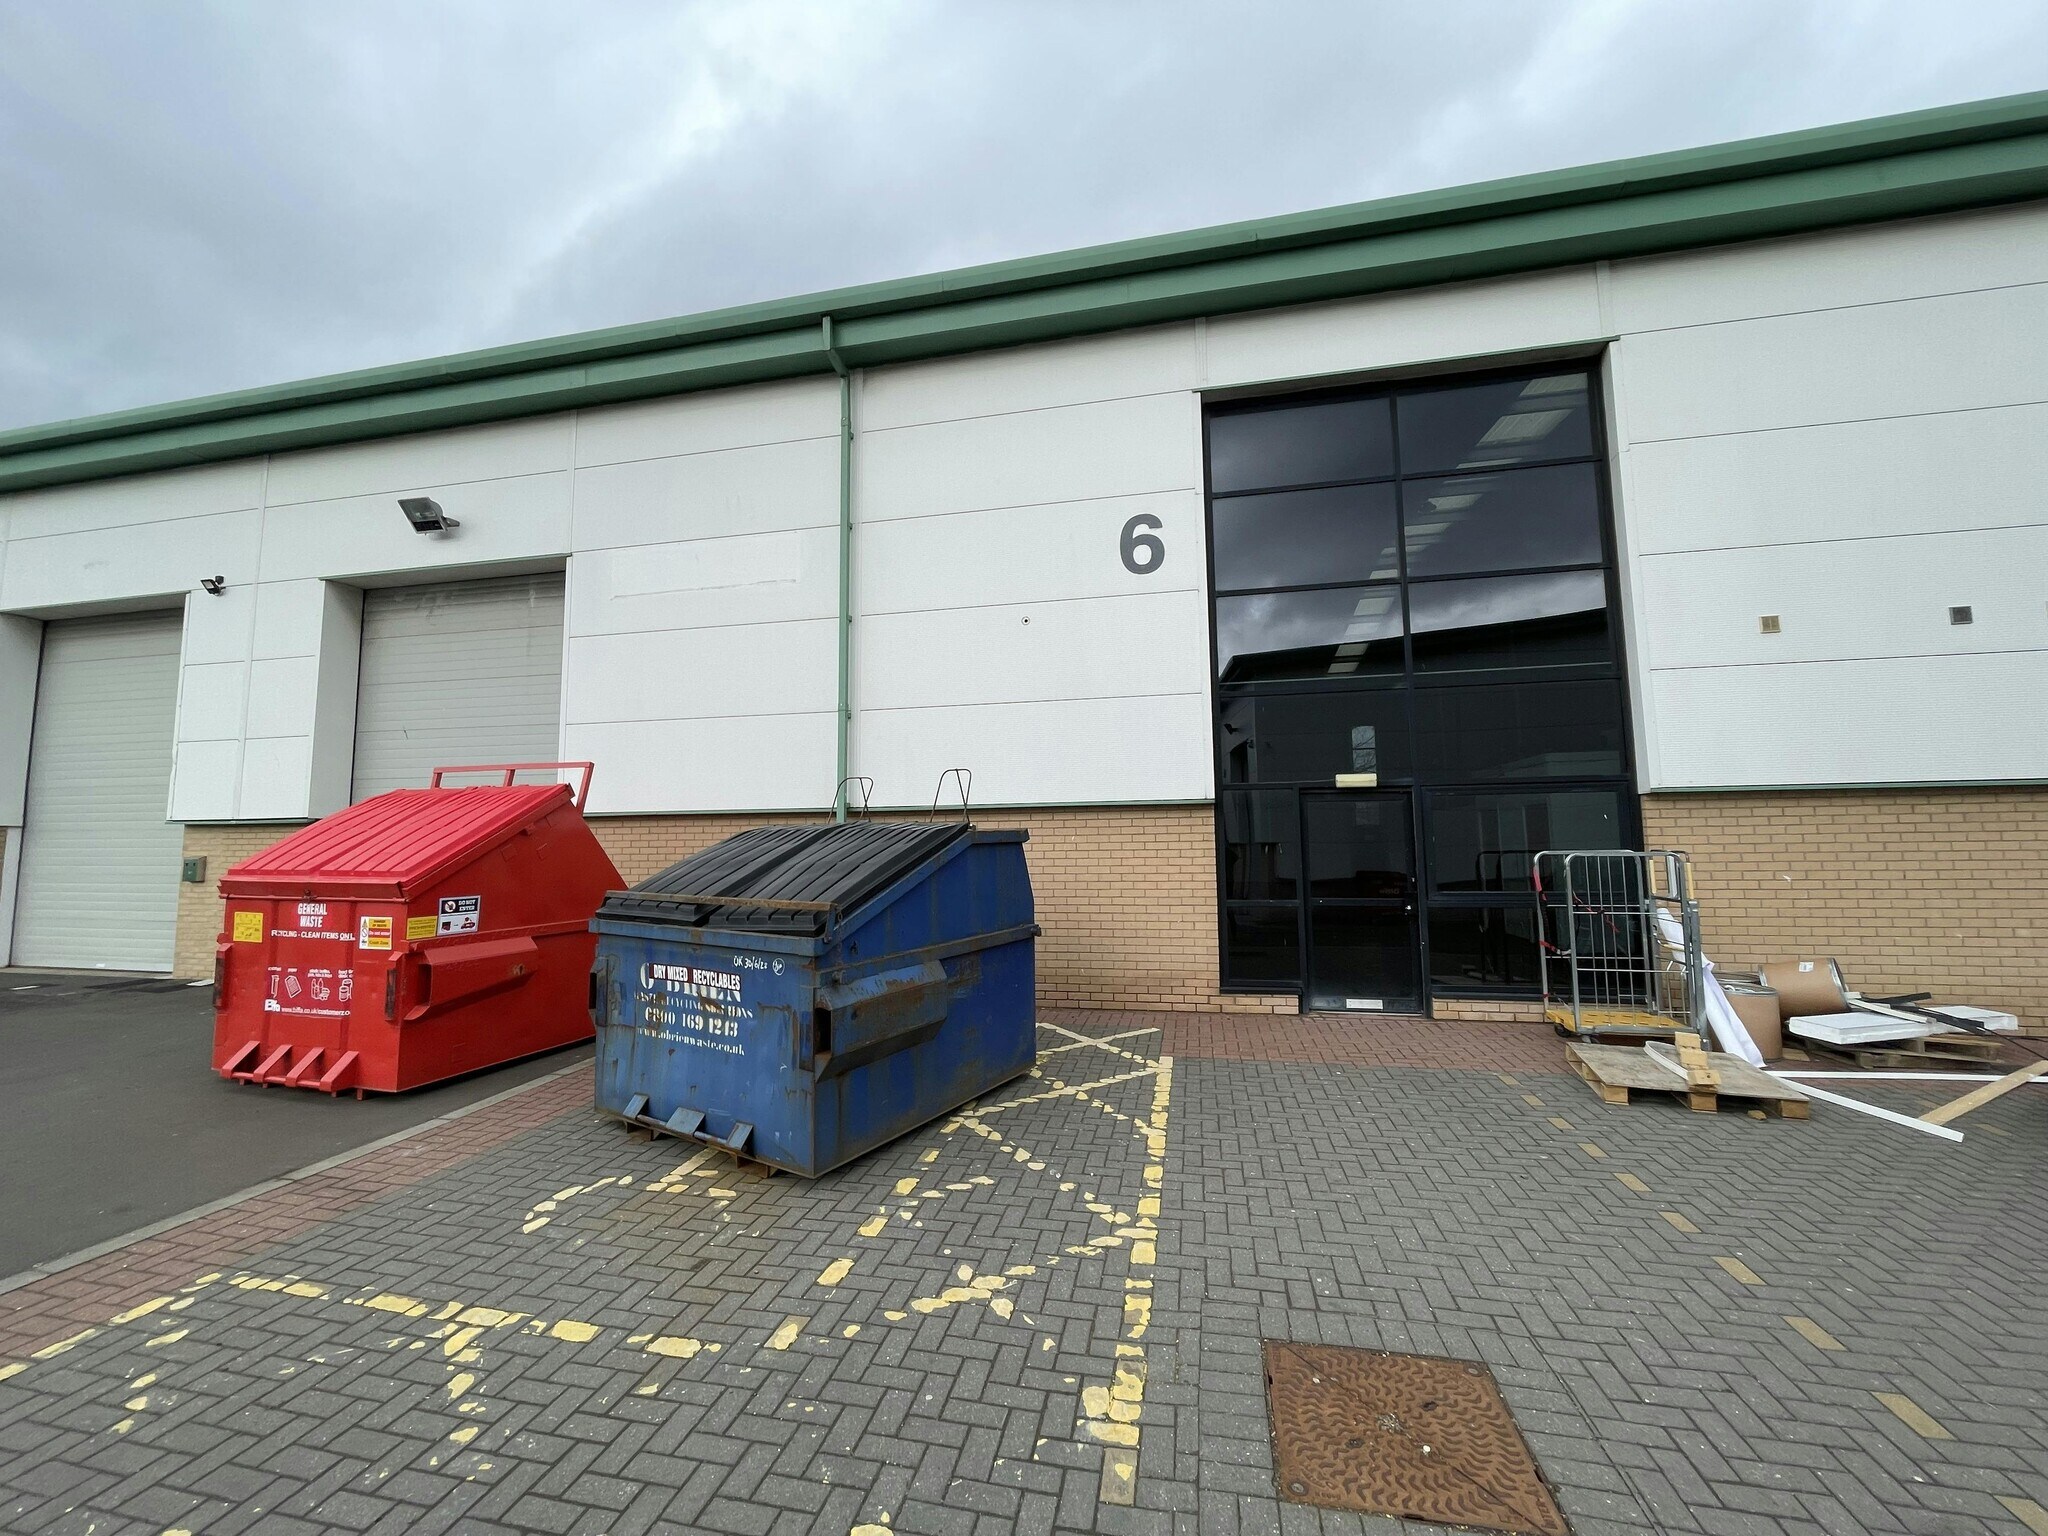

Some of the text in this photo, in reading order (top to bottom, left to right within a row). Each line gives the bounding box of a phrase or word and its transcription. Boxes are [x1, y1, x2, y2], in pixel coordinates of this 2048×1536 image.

[1119, 513, 1166, 575] 6
[298, 902, 328, 916] GENERAL
[299, 915, 324, 928] WASTE
[301, 931, 321, 939] CLEAN
[321, 932, 340, 940] ITEMS
[339, 932, 356, 941] ONL
[653, 964, 667, 980] DRY
[667, 965, 688, 982] MIXED
[692, 968, 741, 991] RECYCLABLES
[682, 1013, 704, 1031] 169
